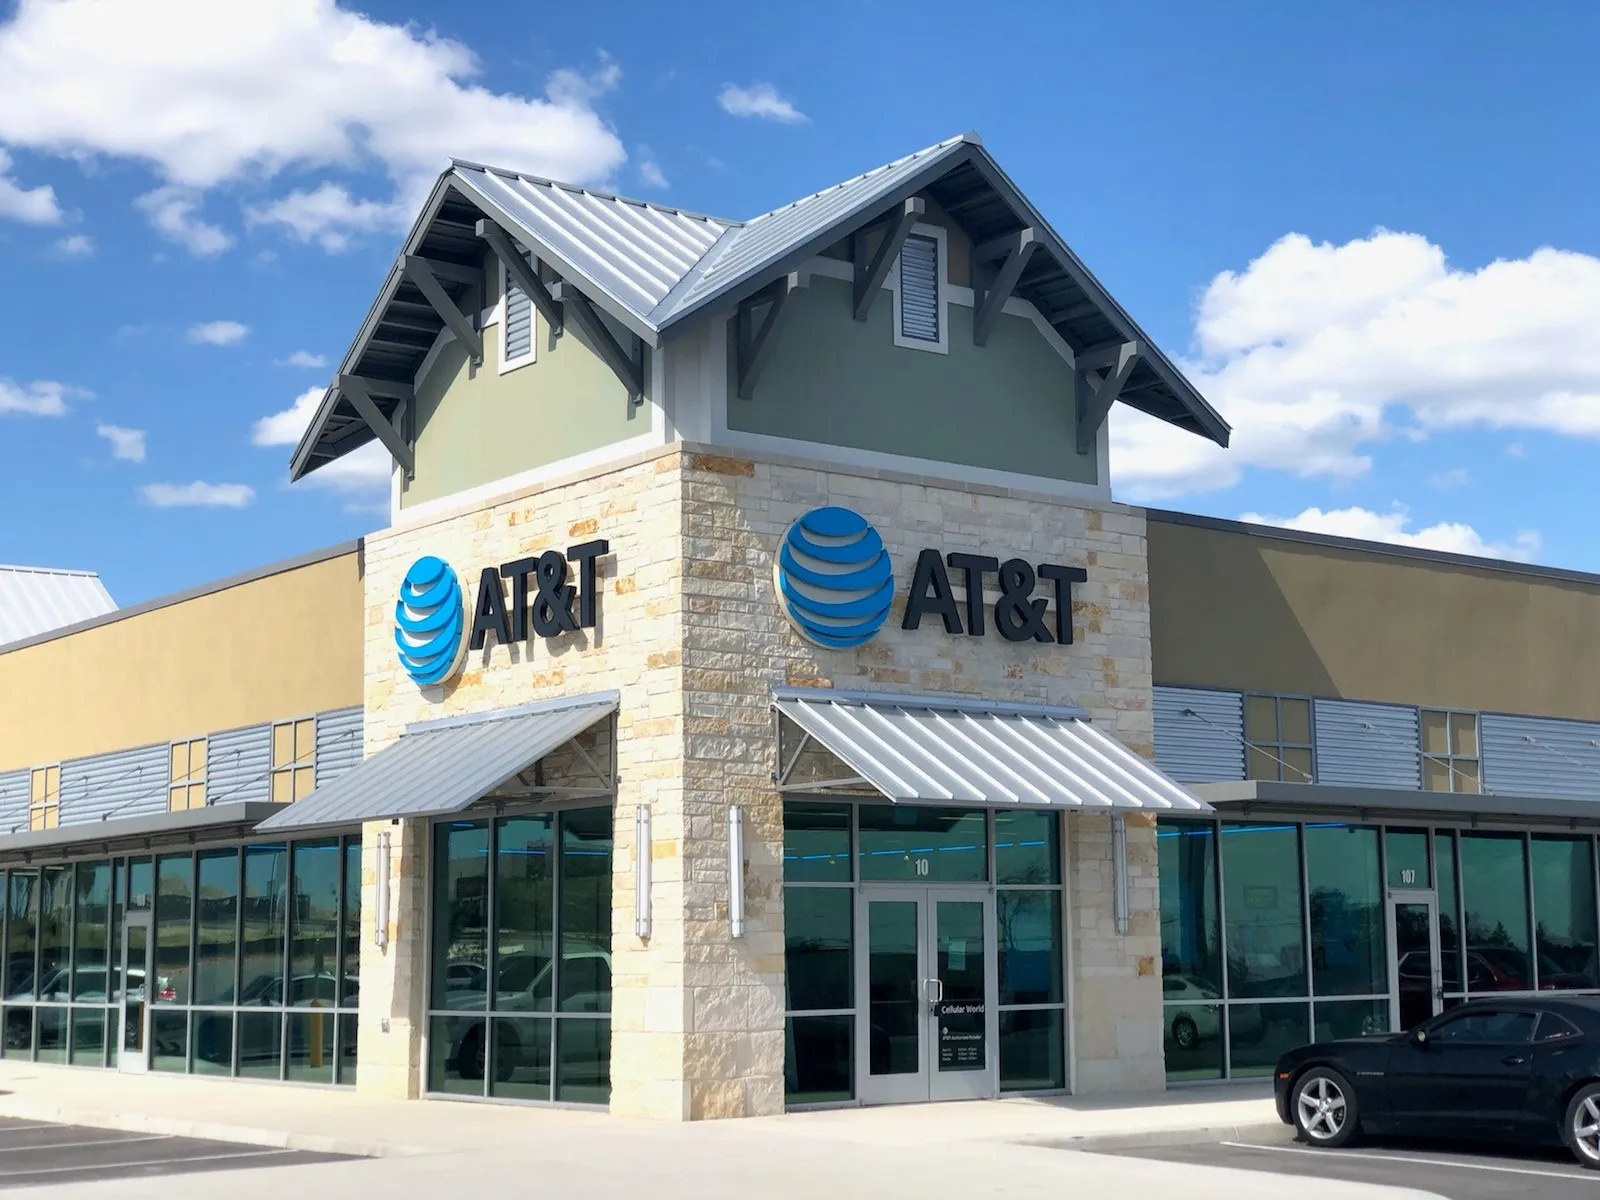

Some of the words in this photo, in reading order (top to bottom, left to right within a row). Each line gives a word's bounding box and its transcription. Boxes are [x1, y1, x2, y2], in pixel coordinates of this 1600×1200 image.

[470, 539, 609, 650] AT&T
[902, 549, 1087, 645] AT&T
[915, 858, 929, 876] 10
[1401, 869, 1416, 884] 107
[941, 1004, 965, 1014] Cellular
[966, 1004, 985, 1013] World
